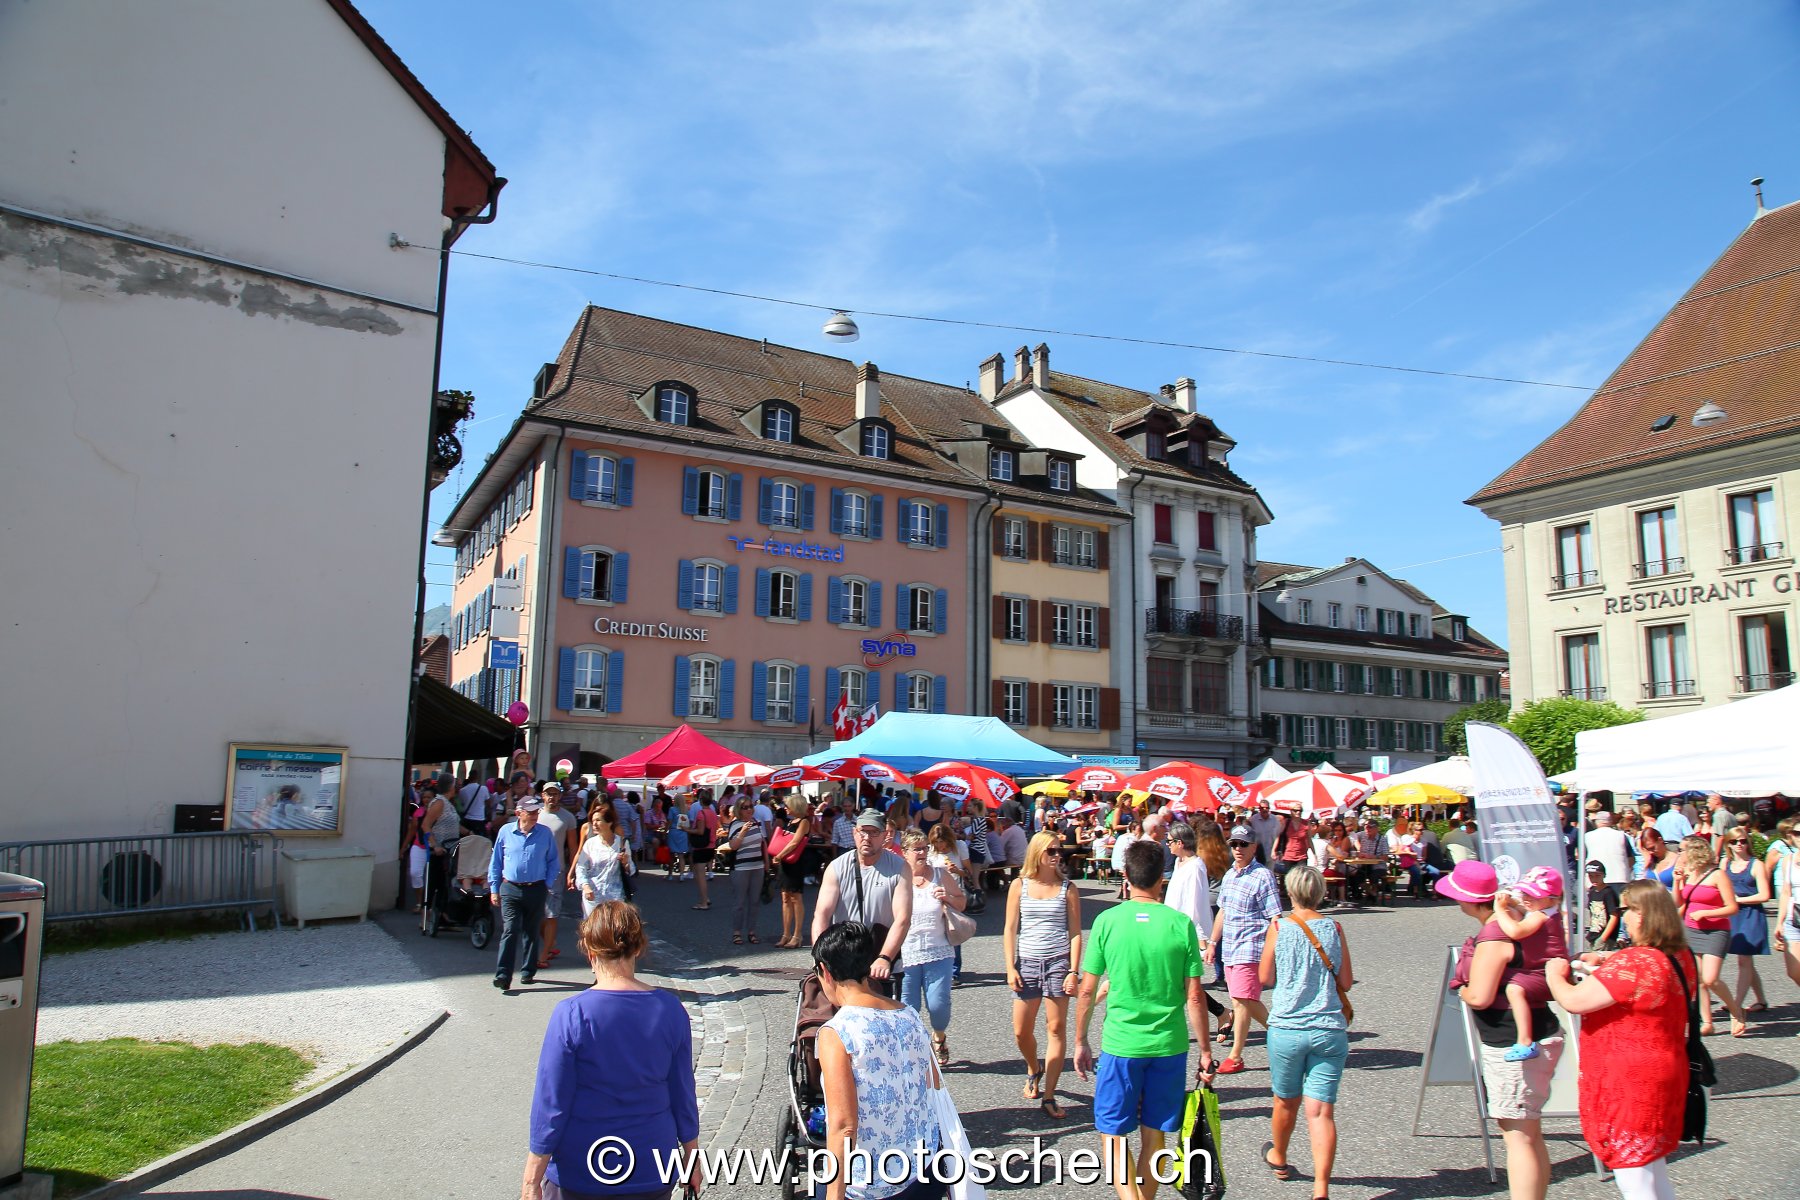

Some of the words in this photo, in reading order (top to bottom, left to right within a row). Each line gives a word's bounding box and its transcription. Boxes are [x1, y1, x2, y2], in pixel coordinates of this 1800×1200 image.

[764, 539, 845, 563] randstad
[1604, 577, 1757, 615] RESTAURANT
[594, 617, 656, 638] CREDIT
[657, 622, 709, 642] SUISSE
[861, 639, 917, 657] syna
[239, 762, 283, 772] Coiffeur
[938, 784, 964, 794] rivella
[1154, 785, 1181, 794] rivella
